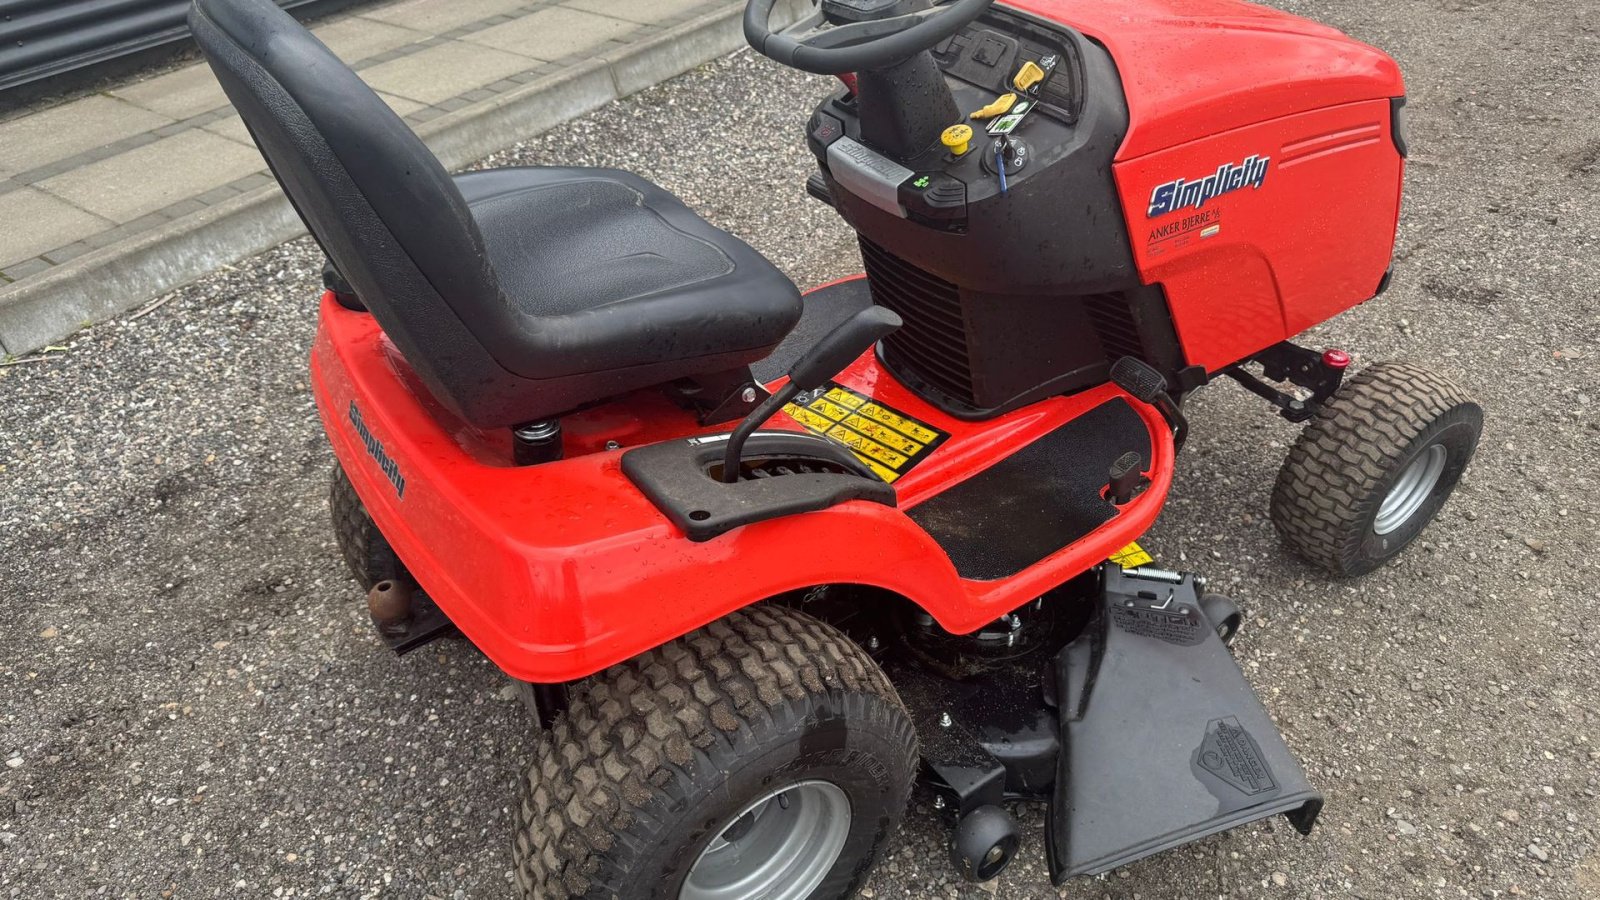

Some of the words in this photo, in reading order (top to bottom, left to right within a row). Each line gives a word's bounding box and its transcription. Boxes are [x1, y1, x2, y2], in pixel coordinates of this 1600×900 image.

[1147, 154, 1270, 218] Simplicity
[1148, 221, 1180, 242] ANKER
[1182, 210, 1211, 231] BJERRE
[349, 400, 405, 500] Simplicity
